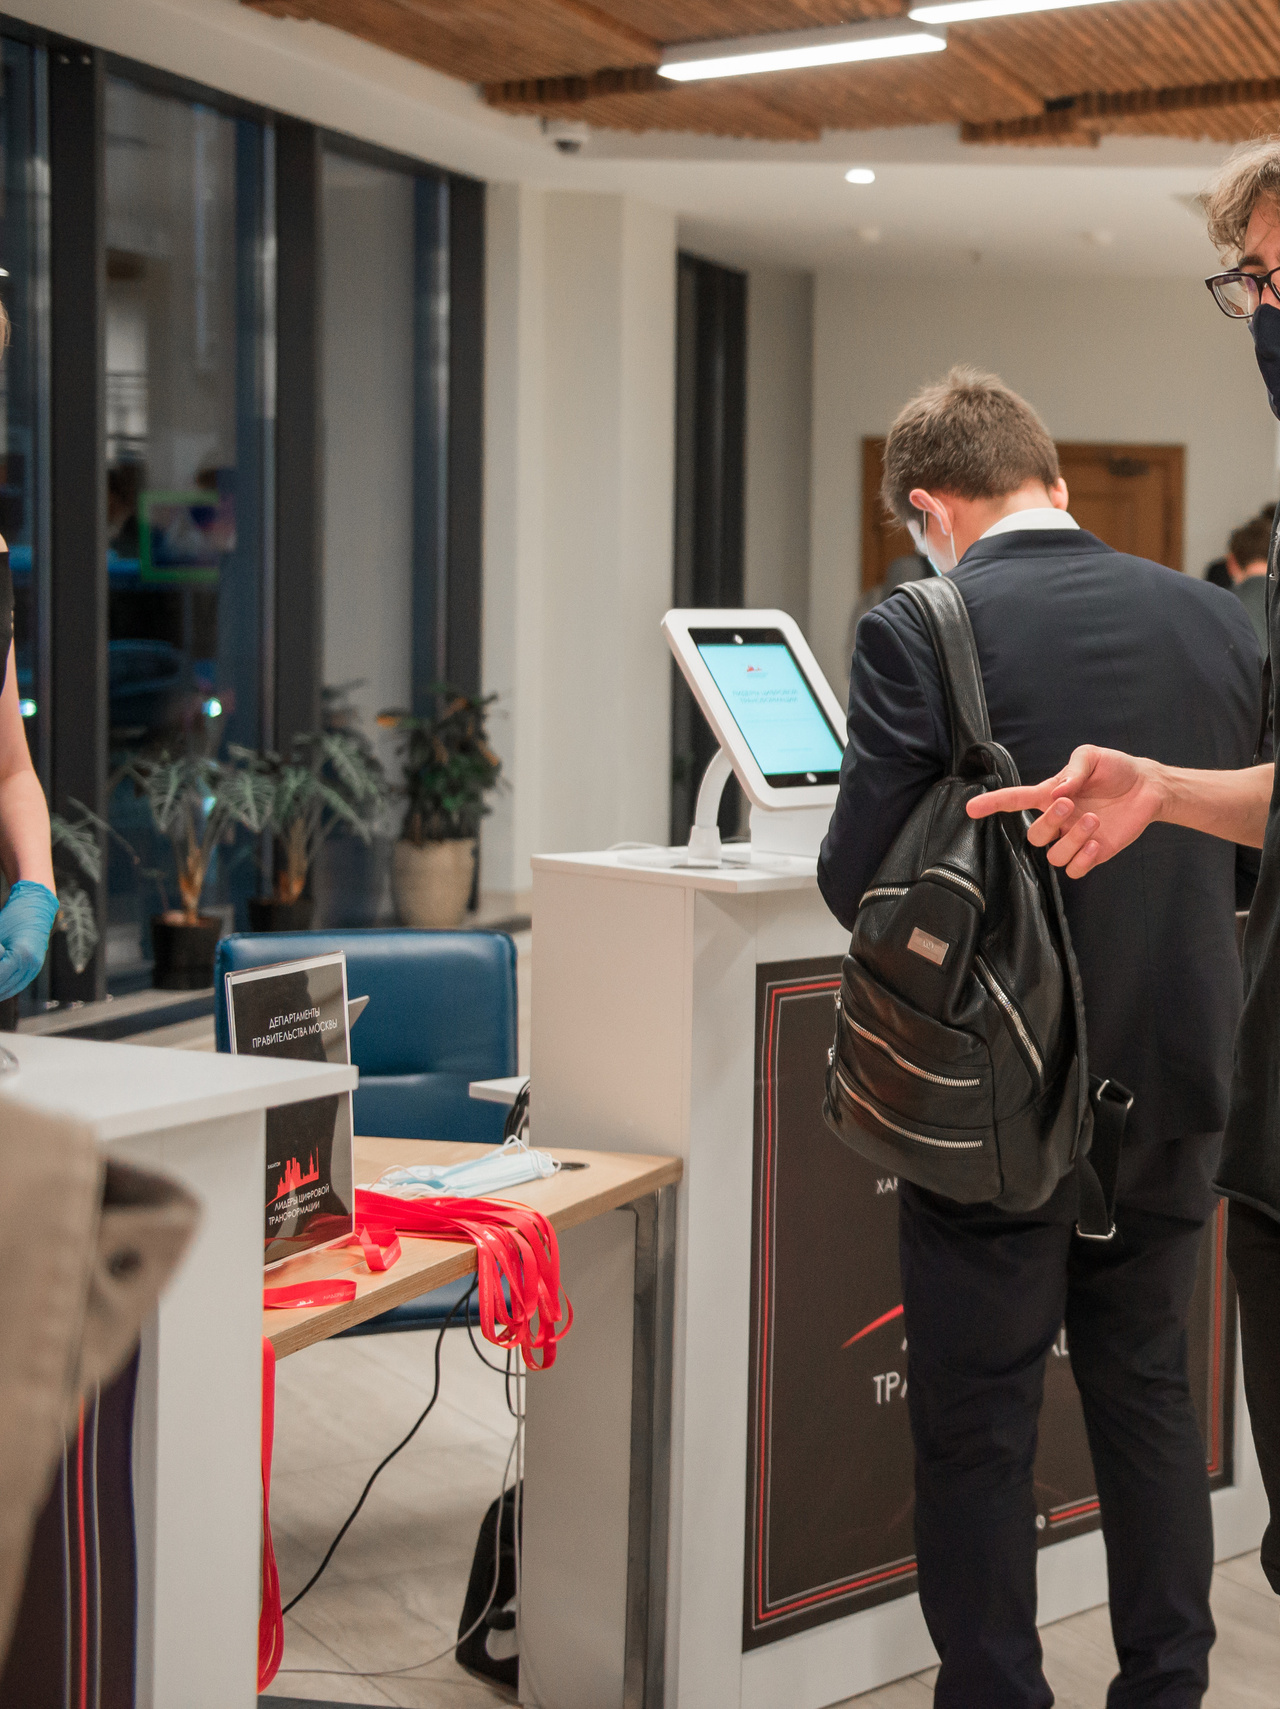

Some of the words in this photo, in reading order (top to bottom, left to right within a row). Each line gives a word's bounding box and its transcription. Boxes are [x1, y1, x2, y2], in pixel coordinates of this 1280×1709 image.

[268, 1007, 321, 1030] ДЕПАРТАМЕНТЫ
[252, 1027, 308, 1048] ПРАВИТЕЛЬСТВА
[308, 1019, 338, 1035] МОСКВЫ
[274, 1196, 298, 1211] ЛИДЕРЫ
[298, 1183, 330, 1203] ЦИФРОВОЙ
[268, 1201, 320, 1225] ТРАНСФОРМАЦИИ
